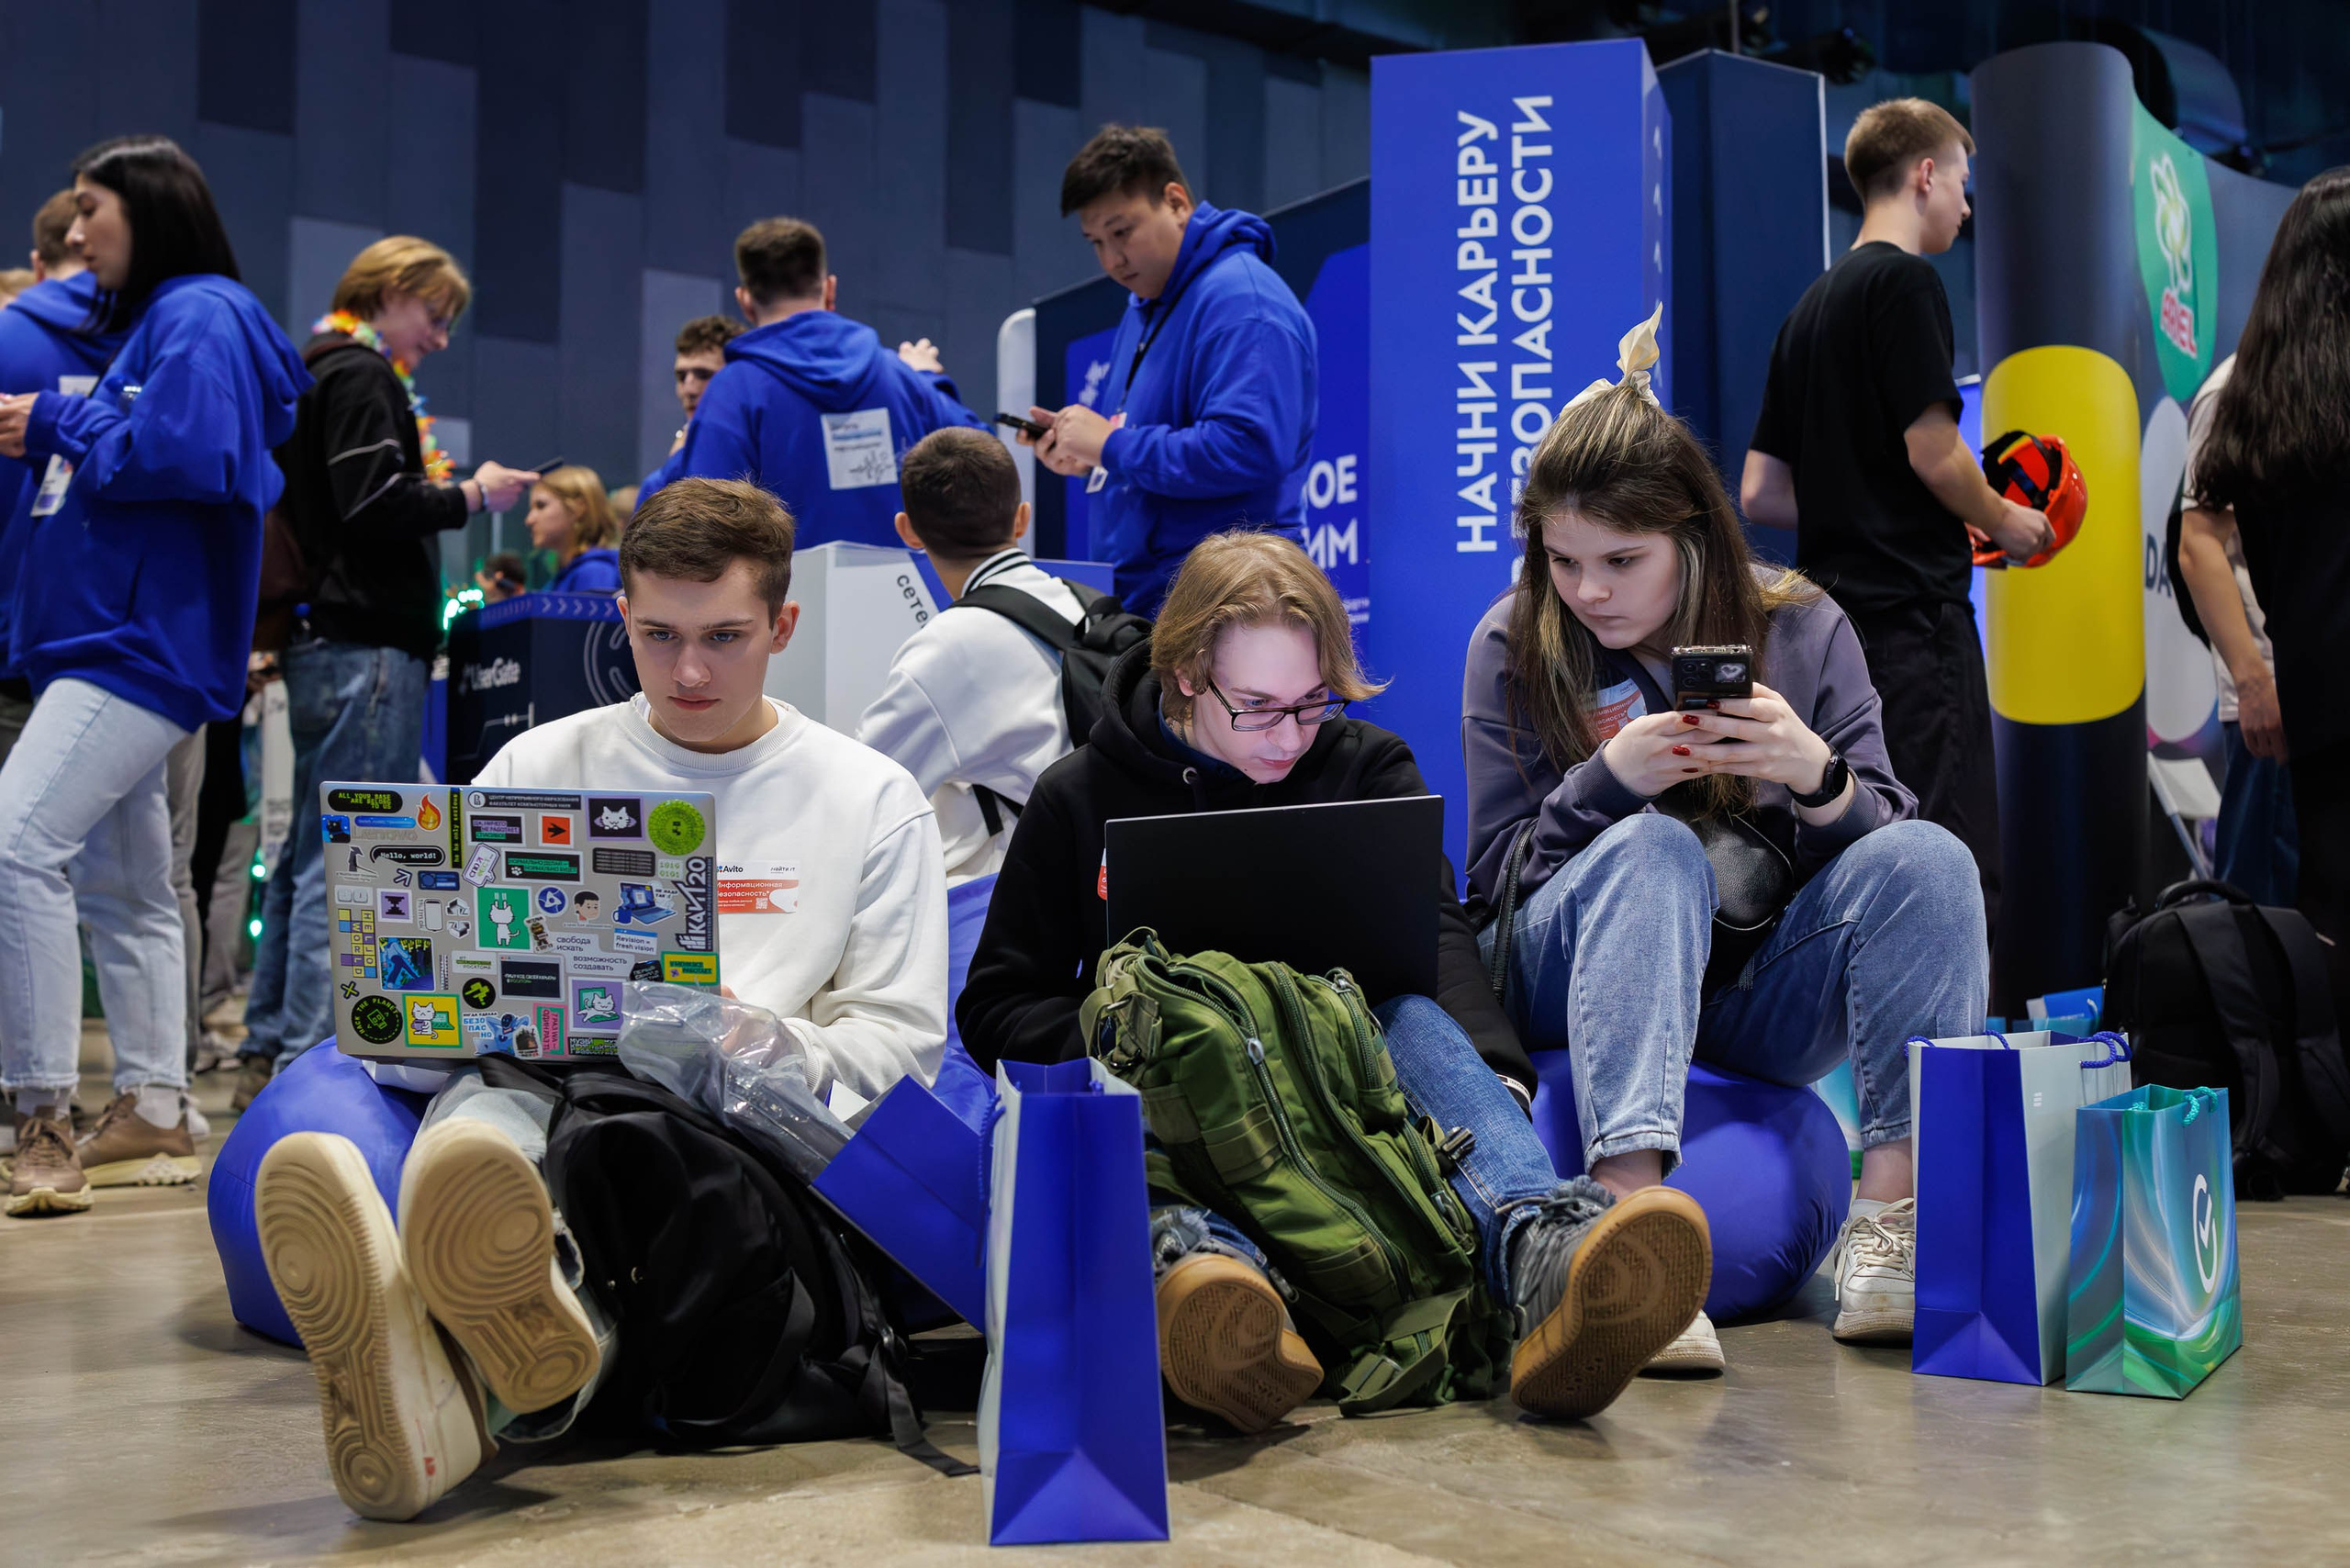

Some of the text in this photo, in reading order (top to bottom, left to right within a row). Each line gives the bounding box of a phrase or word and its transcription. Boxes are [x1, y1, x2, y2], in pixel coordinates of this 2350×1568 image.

[2160, 288, 2198, 359] ARIEL
[1456, 110, 1499, 554] НАЧНИ КАРЬЕРУ
[1302, 454, 1358, 510] ОЕ
[897, 575, 929, 630] сете
[380, 852, 407, 860] Hello,
[556, 936, 591, 945] свобода
[616, 935, 645, 945] Revision
[615, 942, 633, 950] fresh
[573, 956, 628, 965] возможность
[573, 963, 614, 971] создавать
[354, 998, 398, 1035] HACK THE PLANET
